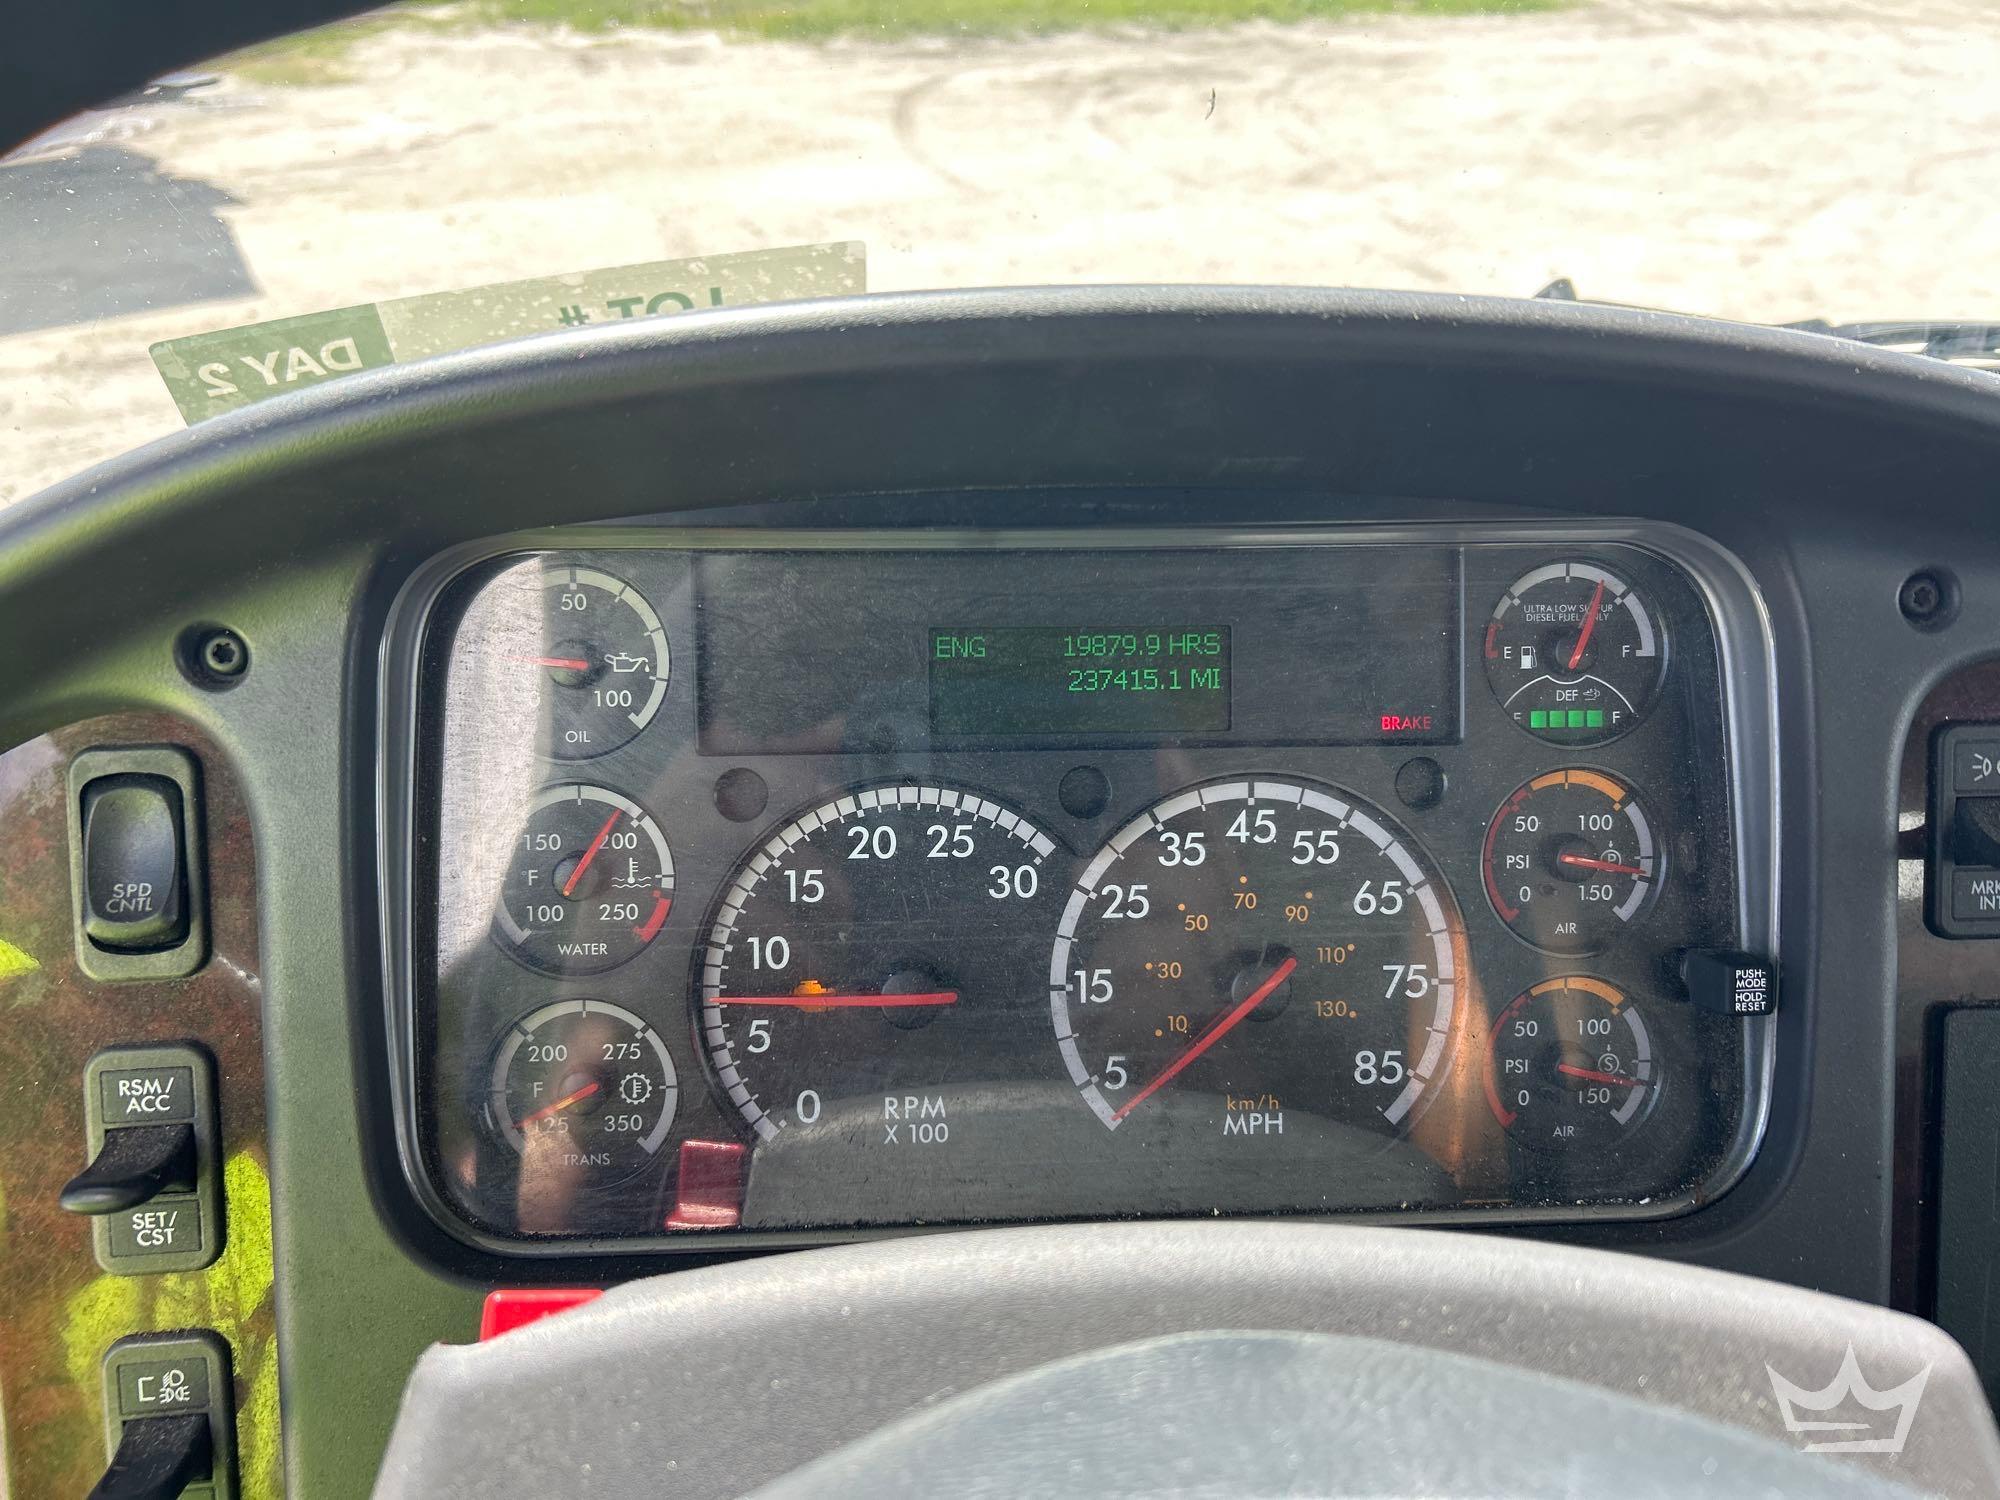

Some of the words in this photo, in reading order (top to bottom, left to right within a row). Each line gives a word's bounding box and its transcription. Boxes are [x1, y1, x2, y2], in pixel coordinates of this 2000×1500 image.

[561, 594, 587, 611] 50
[1523, 604, 1552, 613] ULTRA
[1555, 604, 1576, 612] LOW
[1526, 613, 1556, 622] DIESEL
[1559, 613, 1580, 622] FUEL
[936, 636, 985, 658] ENG
[1064, 634, 1160, 656] 19879.9
[1169, 633, 1221, 655] HRS
[1503, 647, 1511, 659] E
[1622, 645, 1630, 658] F
[1068, 669, 1181, 691] 237415.1
[1190, 668, 1220, 690] MI
[594, 690, 632, 707] 100
[1556, 690, 1578, 701] DEF
[1382, 716, 1431, 730] BRAKE
[1613, 711, 1620, 724] F
[565, 731, 590, 742] OIL
[1225, 809, 1277, 844] 45
[1515, 816, 1539, 832] 50
[1578, 814, 1613, 831] 100
[524, 834, 561, 850] 150
[599, 832, 637, 850] 200
[847, 825, 897, 860] 20
[926, 825, 975, 858] 25
[1158, 832, 1206, 867] 35
[1291, 830, 1340, 865] 55
[1506, 855, 1530, 869] PSI
[113, 882, 152, 898] SPD
[784, 869, 825, 903] 15
[988, 865, 1038, 899] 30
[1353, 880, 1403, 916] 65
[1519, 886, 1531, 902] 0
[1578, 884, 1613, 901] 150
[105, 897, 152, 913] CNTL
[1101, 885, 1150, 920] 25
[1234, 893, 1257, 910] 70
[526, 904, 564, 922] 100
[600, 904, 638, 921] 250
[1285, 906, 1309, 923] 90
[1184, 915, 1209, 932] 50
[1555, 922, 1577, 934] AIR
[558, 943, 608, 955] WATER
[747, 936, 790, 970] 10
[1317, 946, 1346, 964] 110
[1157, 961, 1182, 979] 30
[1735, 969, 1766, 979] PUSH-
[1073, 968, 1114, 1004] 15
[1383, 964, 1429, 999] 75
[1736, 978, 1766, 988] MODE
[1735, 992, 1767, 1002] HOLD-
[1315, 1001, 1346, 1018] 130
[1735, 1002, 1766, 1012] RESET
[1168, 1015, 1188, 1033] 10
[1514, 1021, 1538, 1037] 50
[1576, 1019, 1611, 1035] 100
[747, 1020, 771, 1053] 5
[528, 1045, 567, 1062] 200
[602, 1043, 641, 1060] 275
[1104, 1055, 1128, 1091] 5
[1354, 1050, 1403, 1085] 85
[1505, 1059, 1529, 1074] PSI
[119, 1077, 175, 1096] RSM/
[126, 1095, 171, 1114] ACC
[1227, 1094, 1280, 1111] km/h
[1518, 1090, 1529, 1107] 0
[1577, 1088, 1610, 1104] 150
[796, 1090, 821, 1124] 0
[885, 1096, 947, 1120] RPM
[604, 1115, 643, 1131] 350
[1223, 1113, 1284, 1136] MPH
[884, 1125, 899, 1145] X
[908, 1123, 949, 1144] 100
[1553, 1126, 1575, 1138] AIR
[563, 1153, 610, 1166] TRANS
[132, 1211, 178, 1230] SET/
[137, 1228, 175, 1247] CST
